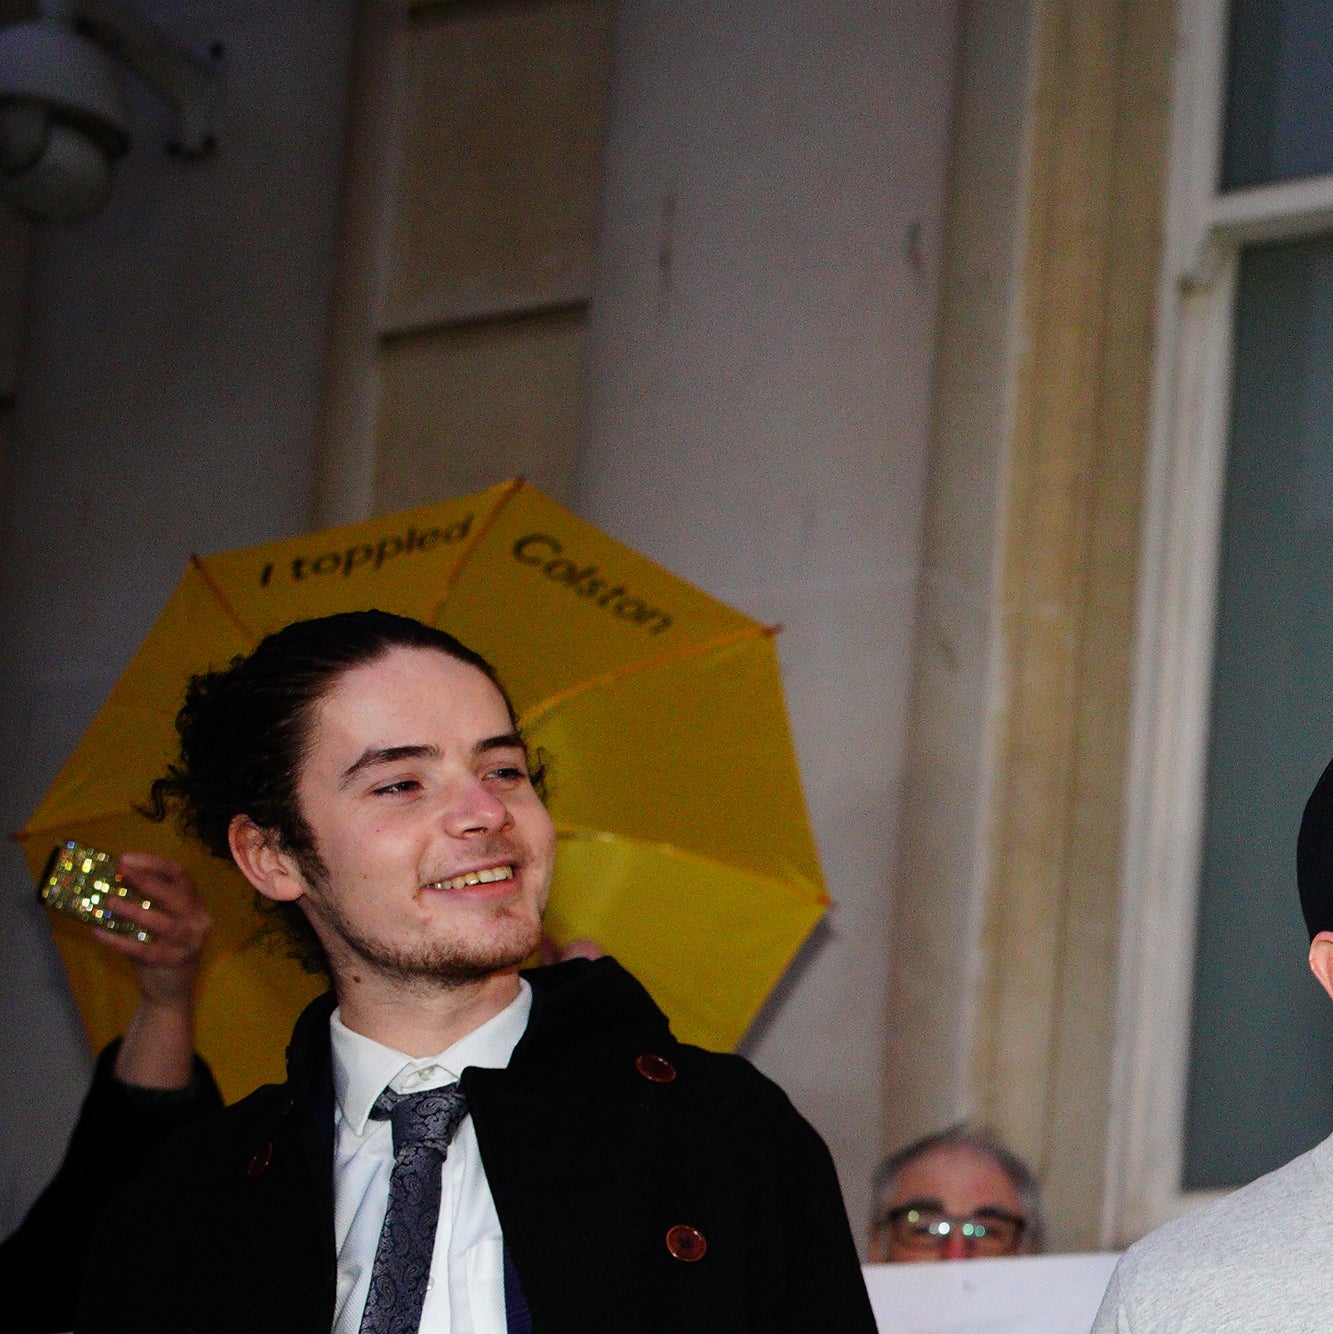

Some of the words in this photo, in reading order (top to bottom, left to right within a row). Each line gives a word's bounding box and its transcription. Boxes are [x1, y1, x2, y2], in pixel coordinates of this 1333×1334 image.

[260, 562, 273, 588] I
[291, 513, 476, 582] toppled
[512, 532, 674, 635] Colston
